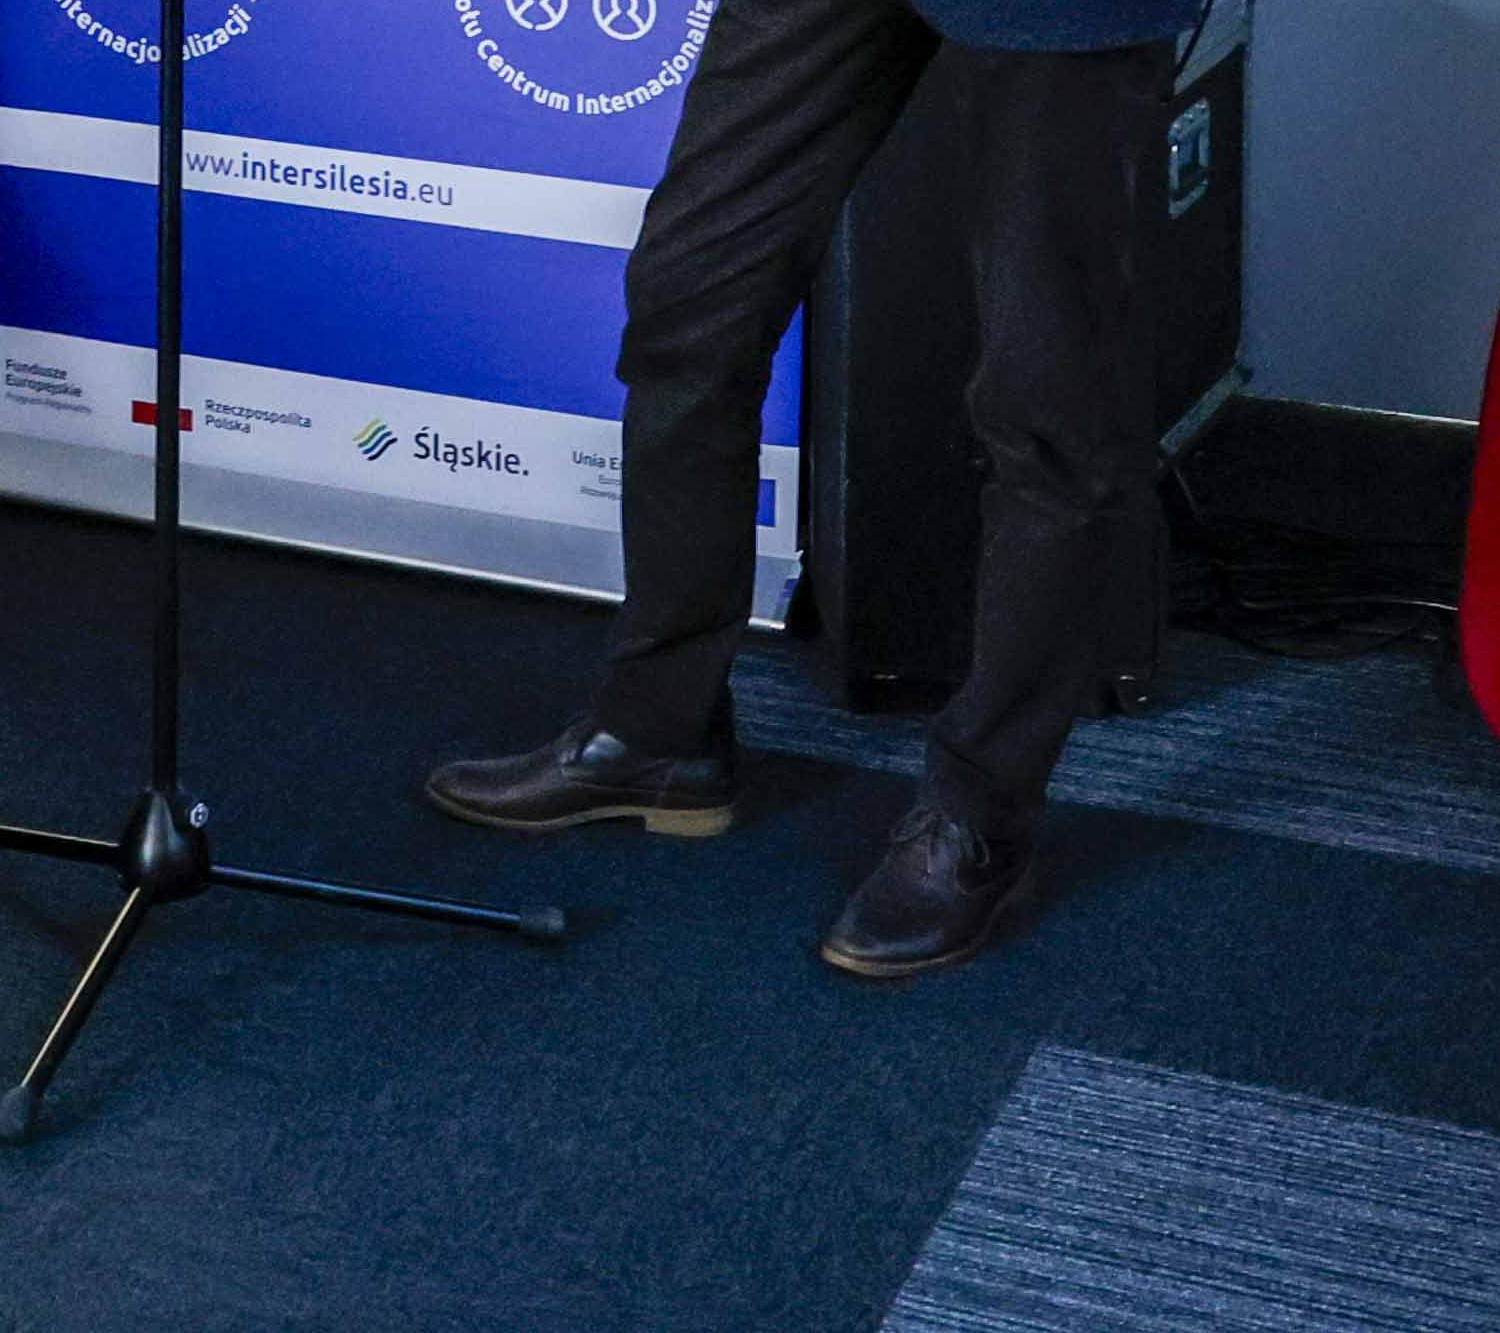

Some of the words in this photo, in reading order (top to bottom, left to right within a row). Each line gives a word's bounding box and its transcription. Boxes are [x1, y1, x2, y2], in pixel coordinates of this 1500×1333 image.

[477, 39, 570, 113] Centrum
[186, 151, 454, 205] ww.intersilesia.eu
[205, 415, 251, 434] Polska
[413, 426, 530, 477] Śląskie.
